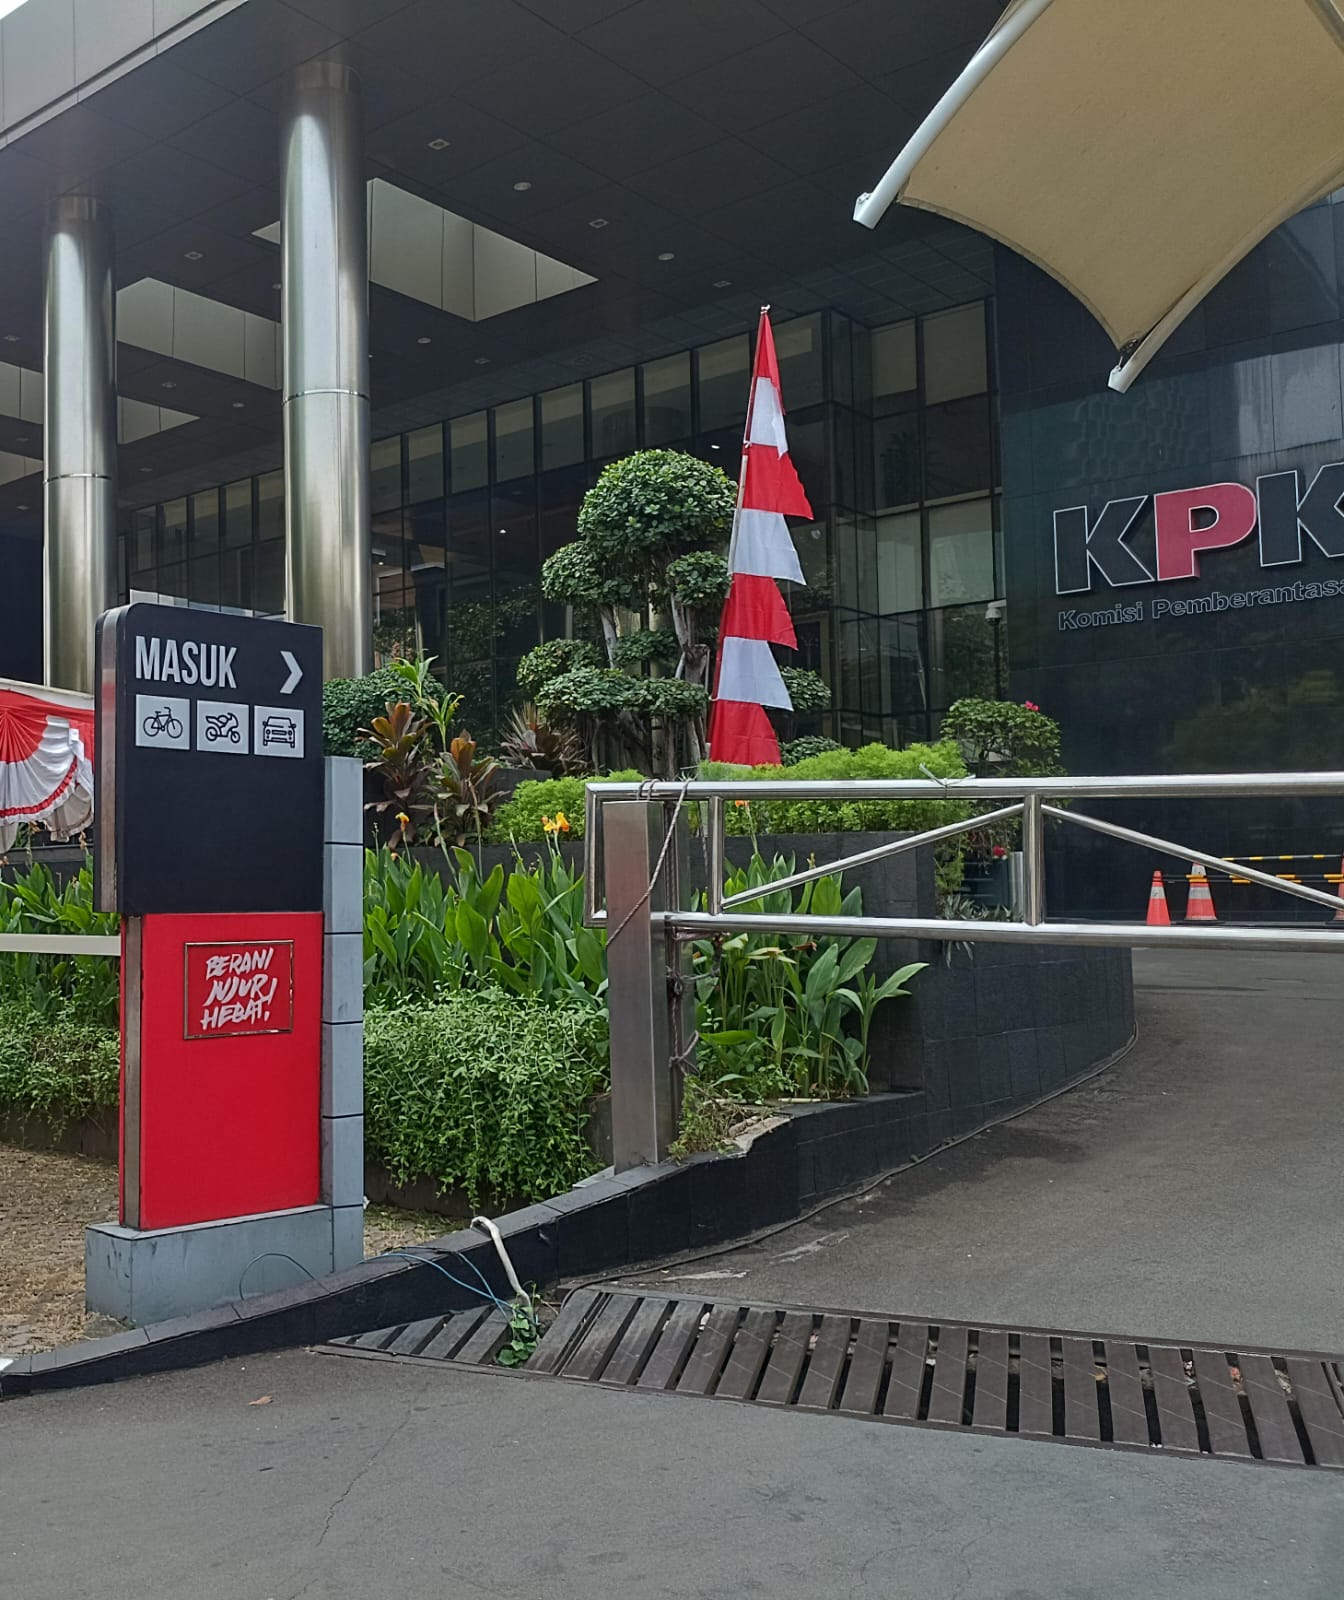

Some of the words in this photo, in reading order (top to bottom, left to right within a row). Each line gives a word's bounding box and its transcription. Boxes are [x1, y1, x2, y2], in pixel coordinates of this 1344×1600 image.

[1053, 462, 1344, 595] KPK
[1058, 601, 1144, 631] Komisi
[1152, 579, 1344, 619] Pemberantas
[135, 635, 237, 689] MASUK
[205, 947, 274, 980] BERANI
